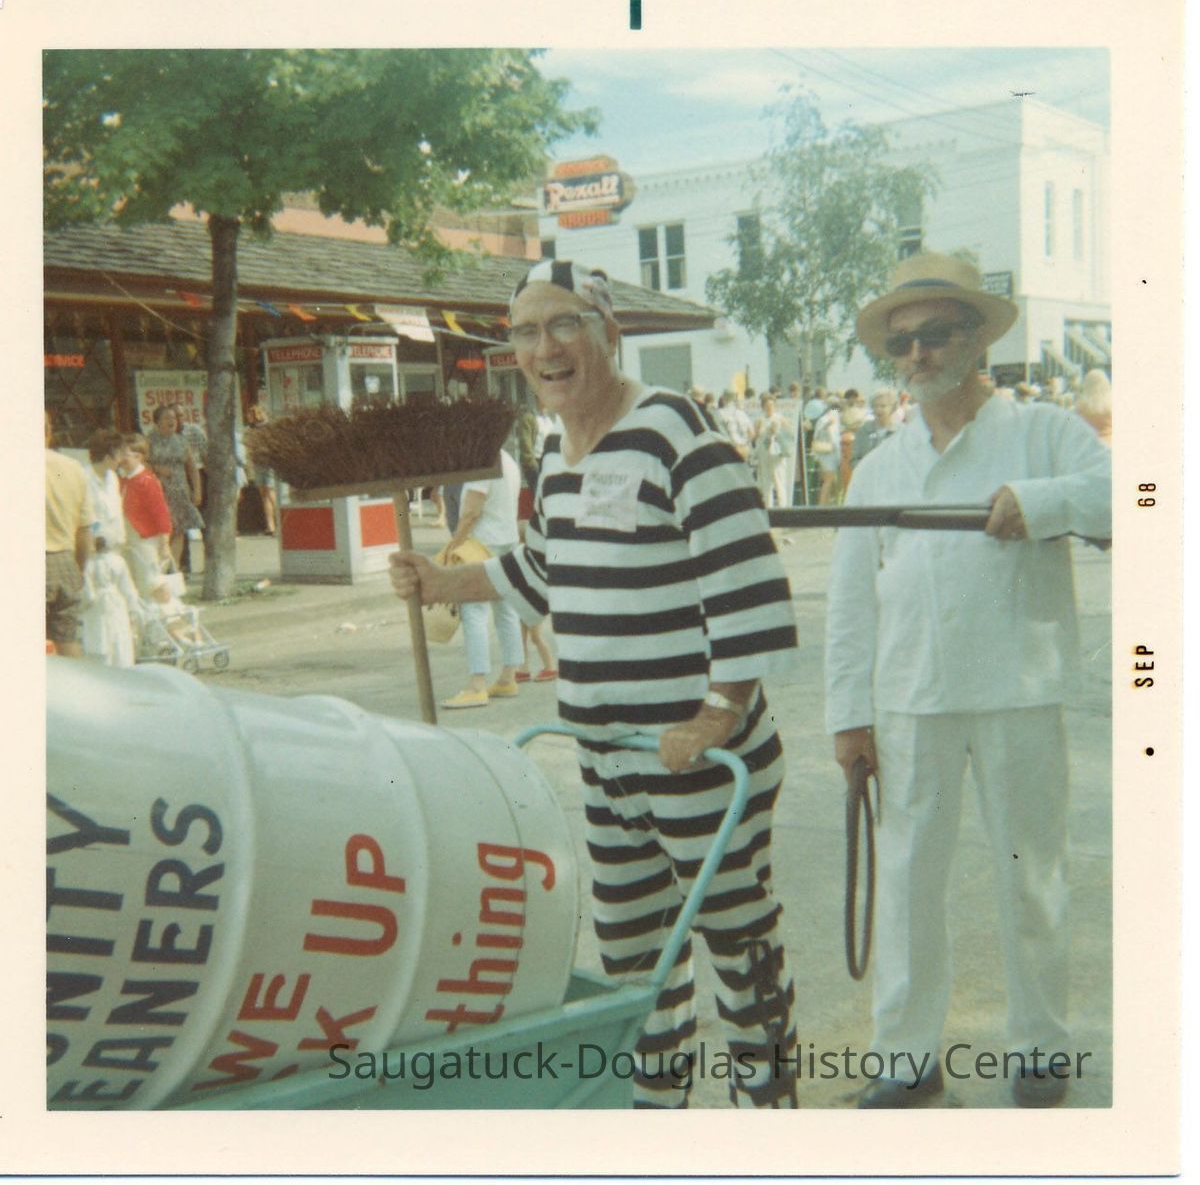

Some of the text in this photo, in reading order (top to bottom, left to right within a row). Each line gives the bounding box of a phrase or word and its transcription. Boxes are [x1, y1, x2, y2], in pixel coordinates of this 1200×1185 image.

[546, 174, 619, 213] Rexall
[269, 348, 322, 361] TELEPHONE
[144, 390, 195, 408] SUPER
[303, 833, 406, 958] UP
[424, 841, 556, 1034] thing
[189, 972, 312, 1092] WE
